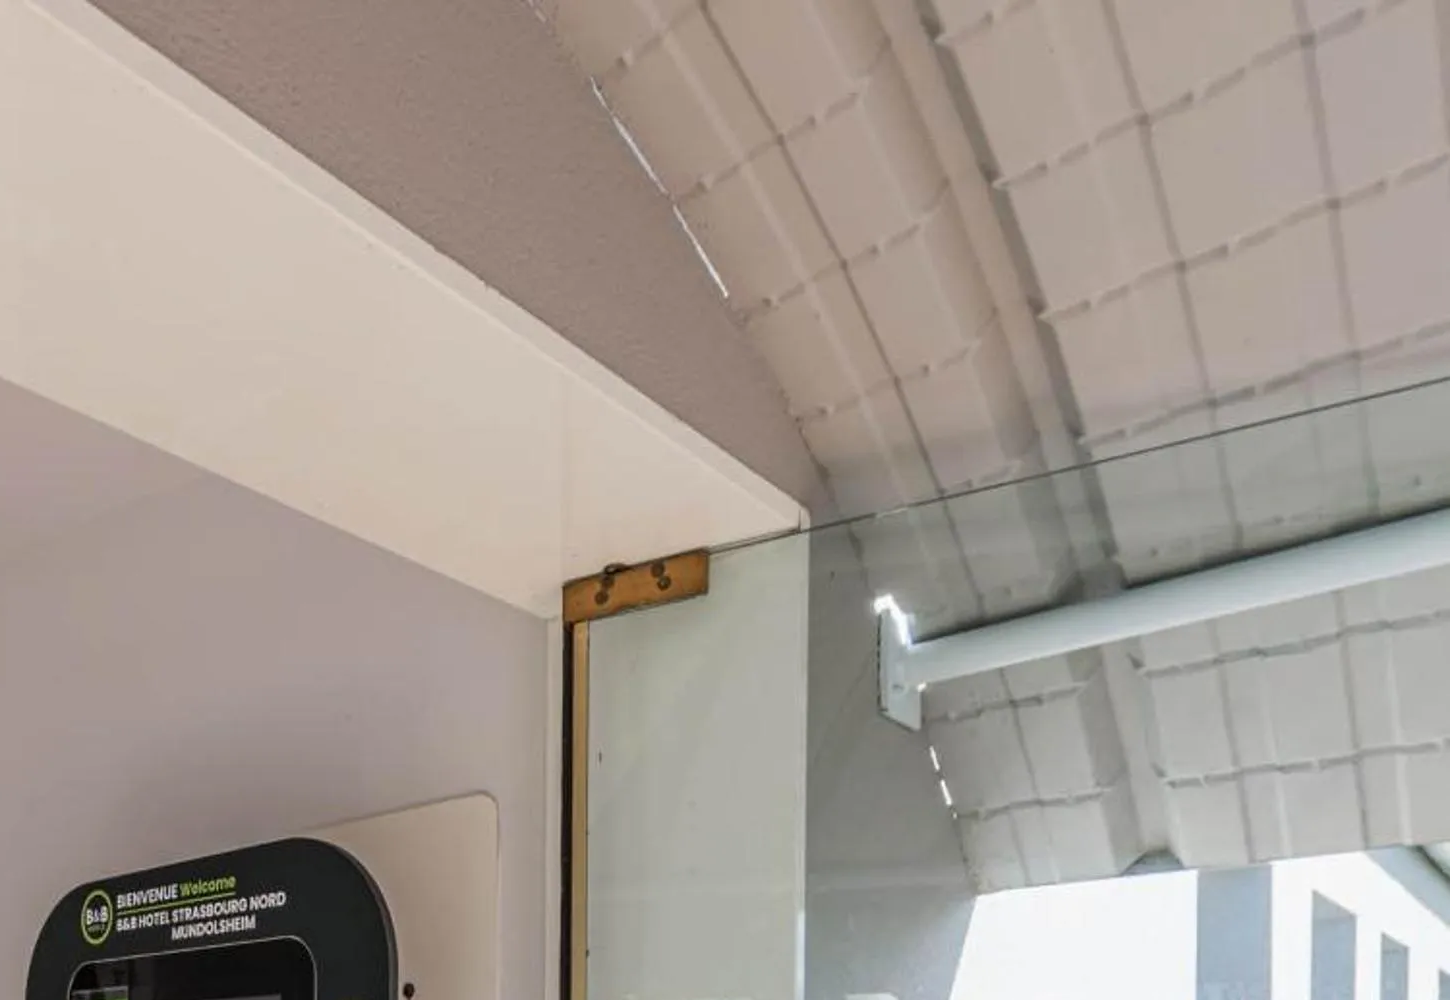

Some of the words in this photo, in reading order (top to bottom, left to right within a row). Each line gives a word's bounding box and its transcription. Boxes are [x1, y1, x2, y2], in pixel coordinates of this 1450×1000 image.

[116, 883, 178, 909] BIENVENUE
[179, 875, 236, 896] Welcome
[86, 906, 108, 925] B&B
[116, 918, 138, 932] B&B
[139, 912, 170, 928] HOTEL
[171, 898, 248, 924] STRASBOURG
[250, 891, 287, 911] NORD
[171, 915, 256, 941] MUNDOLSHEIM
